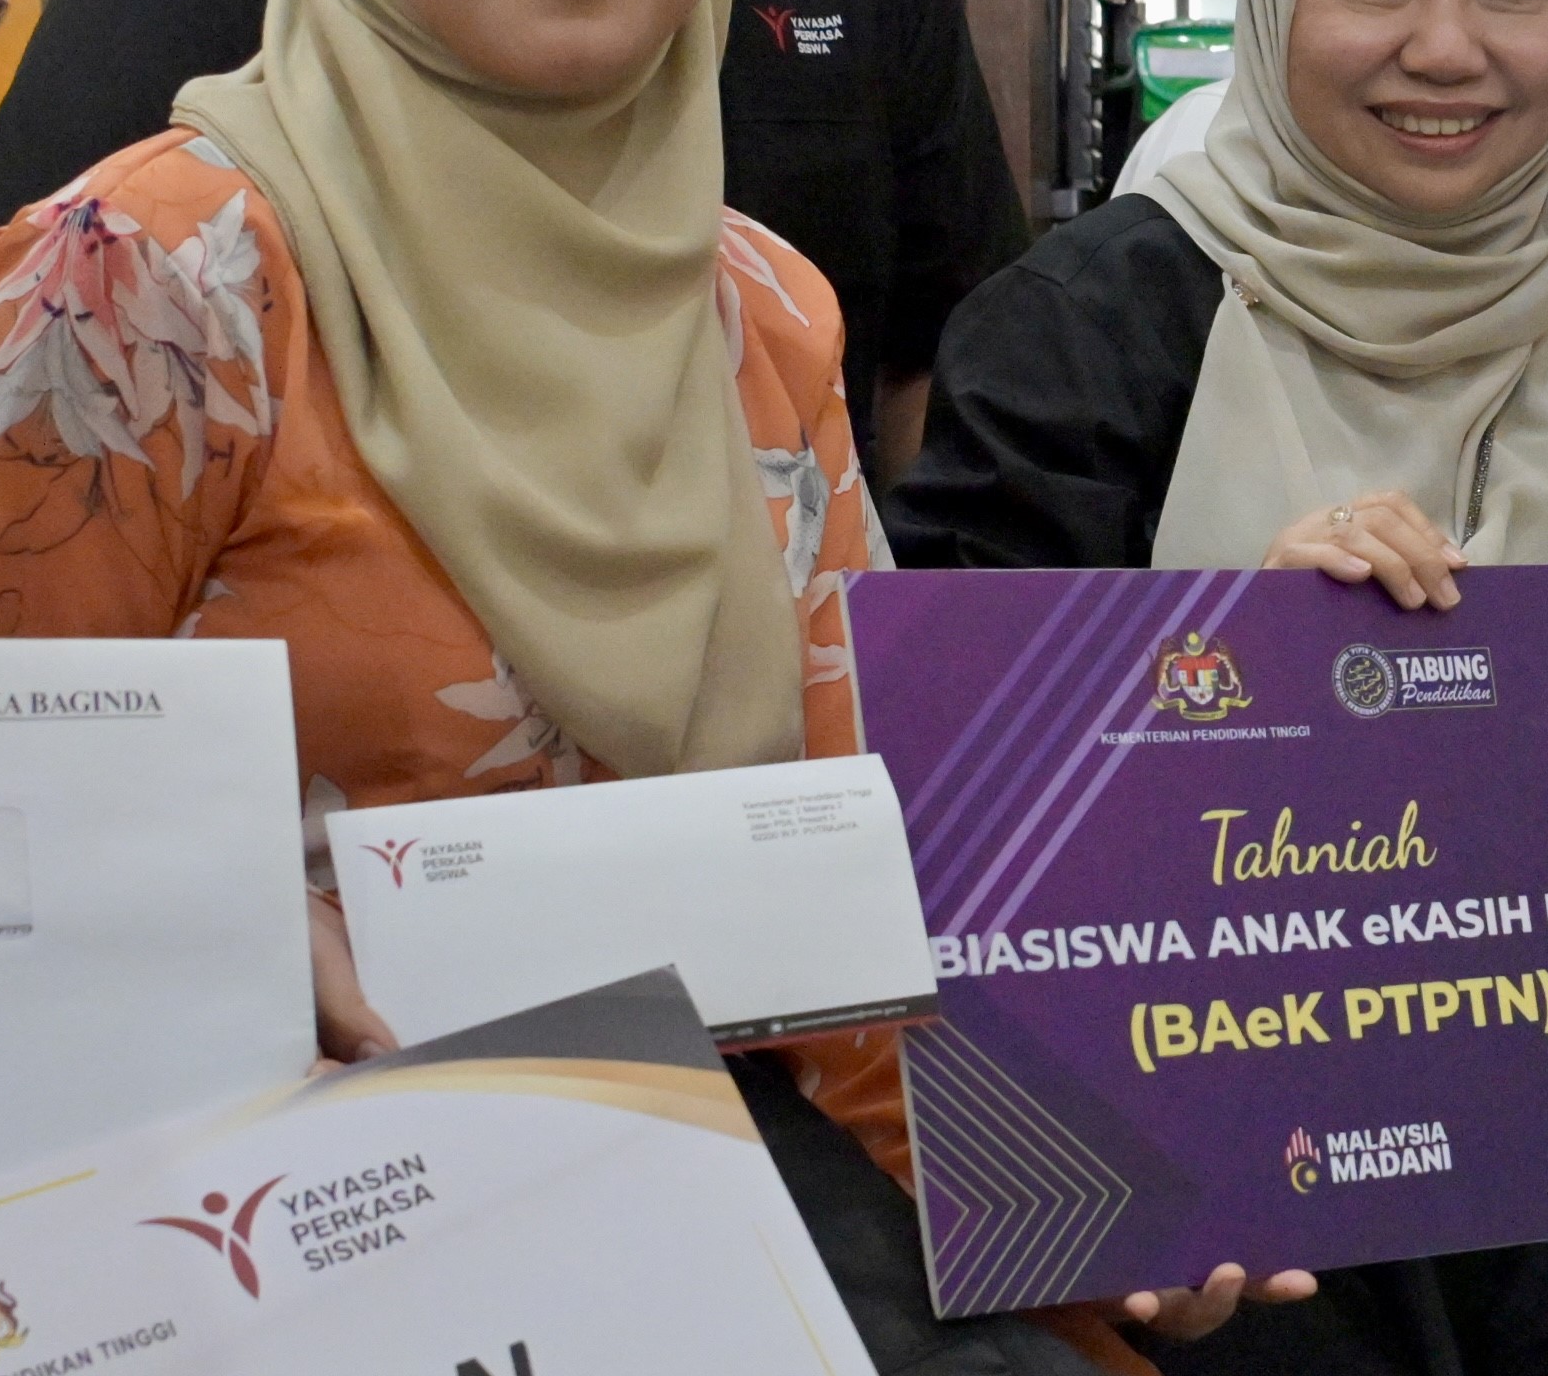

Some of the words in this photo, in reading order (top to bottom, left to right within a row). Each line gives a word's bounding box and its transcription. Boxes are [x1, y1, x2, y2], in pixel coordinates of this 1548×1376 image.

[790, 14, 842, 29] YAYASAN
[793, 28, 843, 41] PERKASA
[797, 41, 831, 54] SISWA
[1396, 654, 1489, 683] TABUNG
[30, 689, 164, 714] BAGINDA
[1400, 682, 1492, 706] Pendidikan
[1101, 730, 1190, 745] KEMENTERIAN
[1192, 727, 1267, 741] PENDIDIKAN
[1269, 725, 1311, 738] TINGGI
[420, 841, 483, 856] YAYASAN
[1200, 800, 1437, 886] Tahniah
[422, 853, 483, 869] PERKASA
[930, 922, 1197, 979] BIASISWA
[1207, 909, 1352, 959] ANAK
[1362, 894, 1533, 946] eKASIH
[1129, 991, 1331, 1074] (BAeK
[1326, 1121, 1449, 1155] MALAYSIA
[1329, 1143, 1452, 1185] MADANI
[279, 1153, 427, 1217] YAYASAN
[290, 1183, 436, 1246] PERKASA
[303, 1222, 406, 1272] SISWA
[97, 1318, 179, 1361] TINGGI
